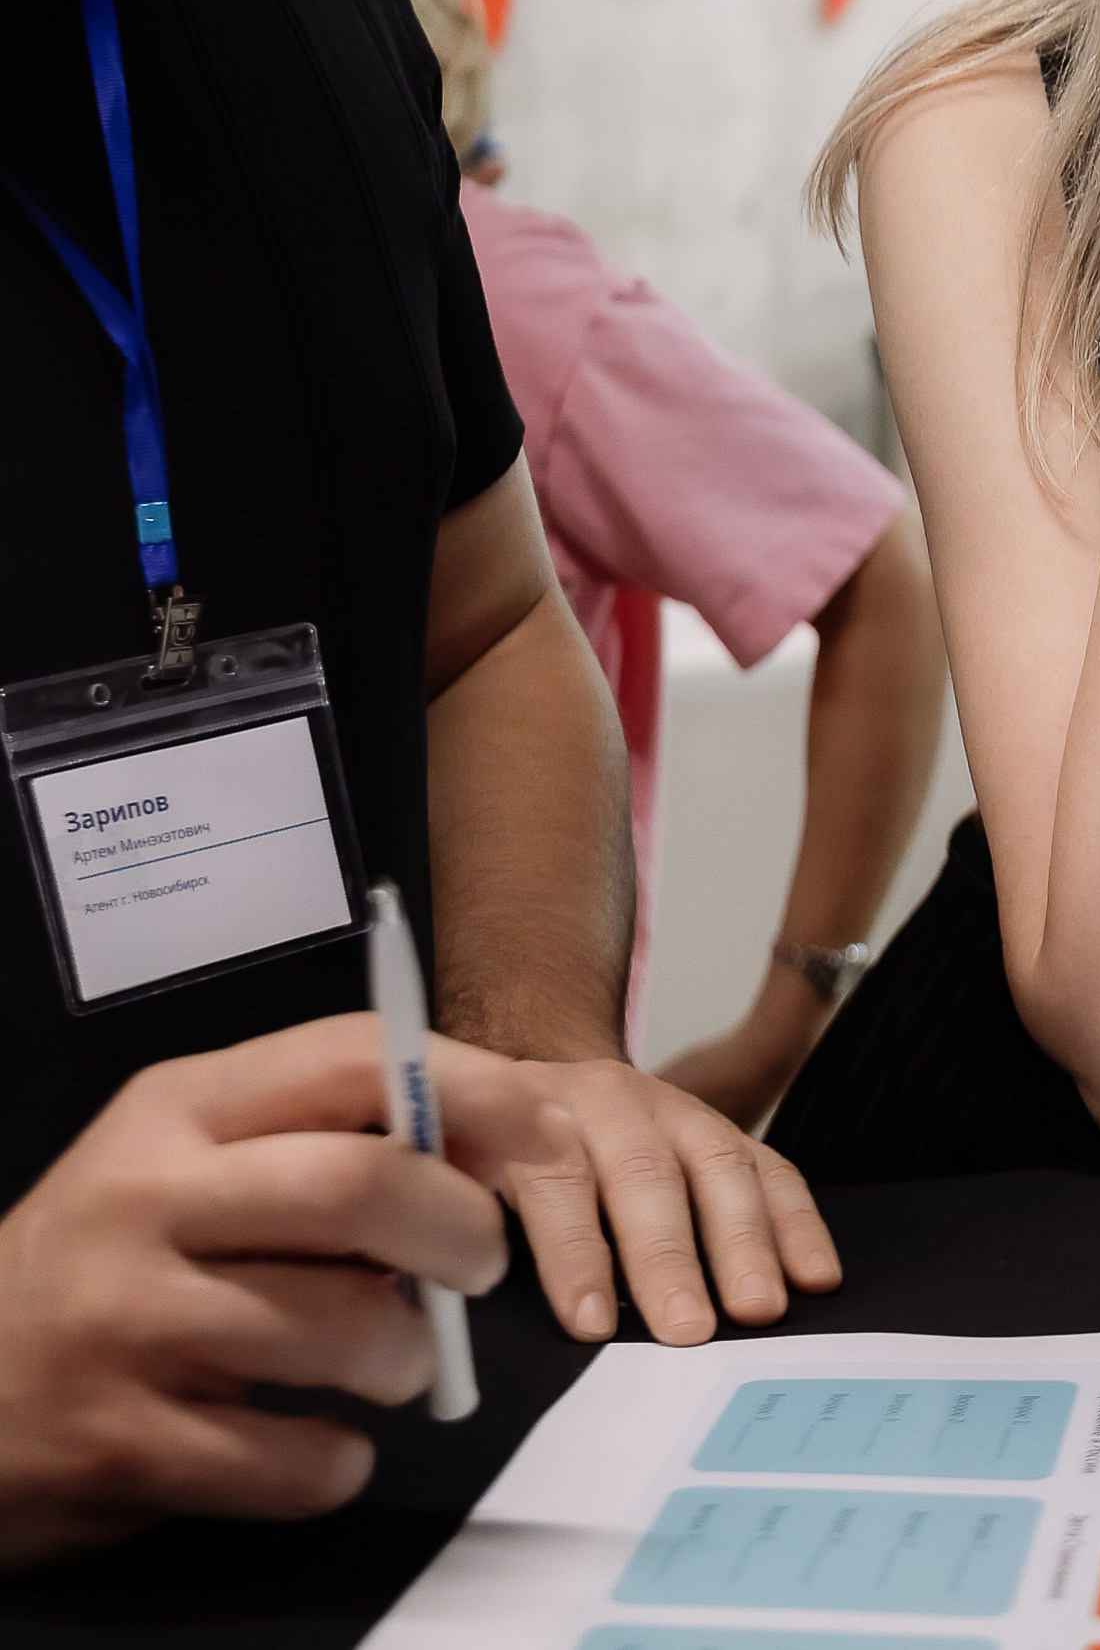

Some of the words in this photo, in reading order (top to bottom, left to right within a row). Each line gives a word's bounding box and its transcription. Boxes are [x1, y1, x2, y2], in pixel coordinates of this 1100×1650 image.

[64, 795, 170, 833] Зарипов
[73, 846, 117, 866] Артем
[132, 875, 210, 901] Новосибирск
